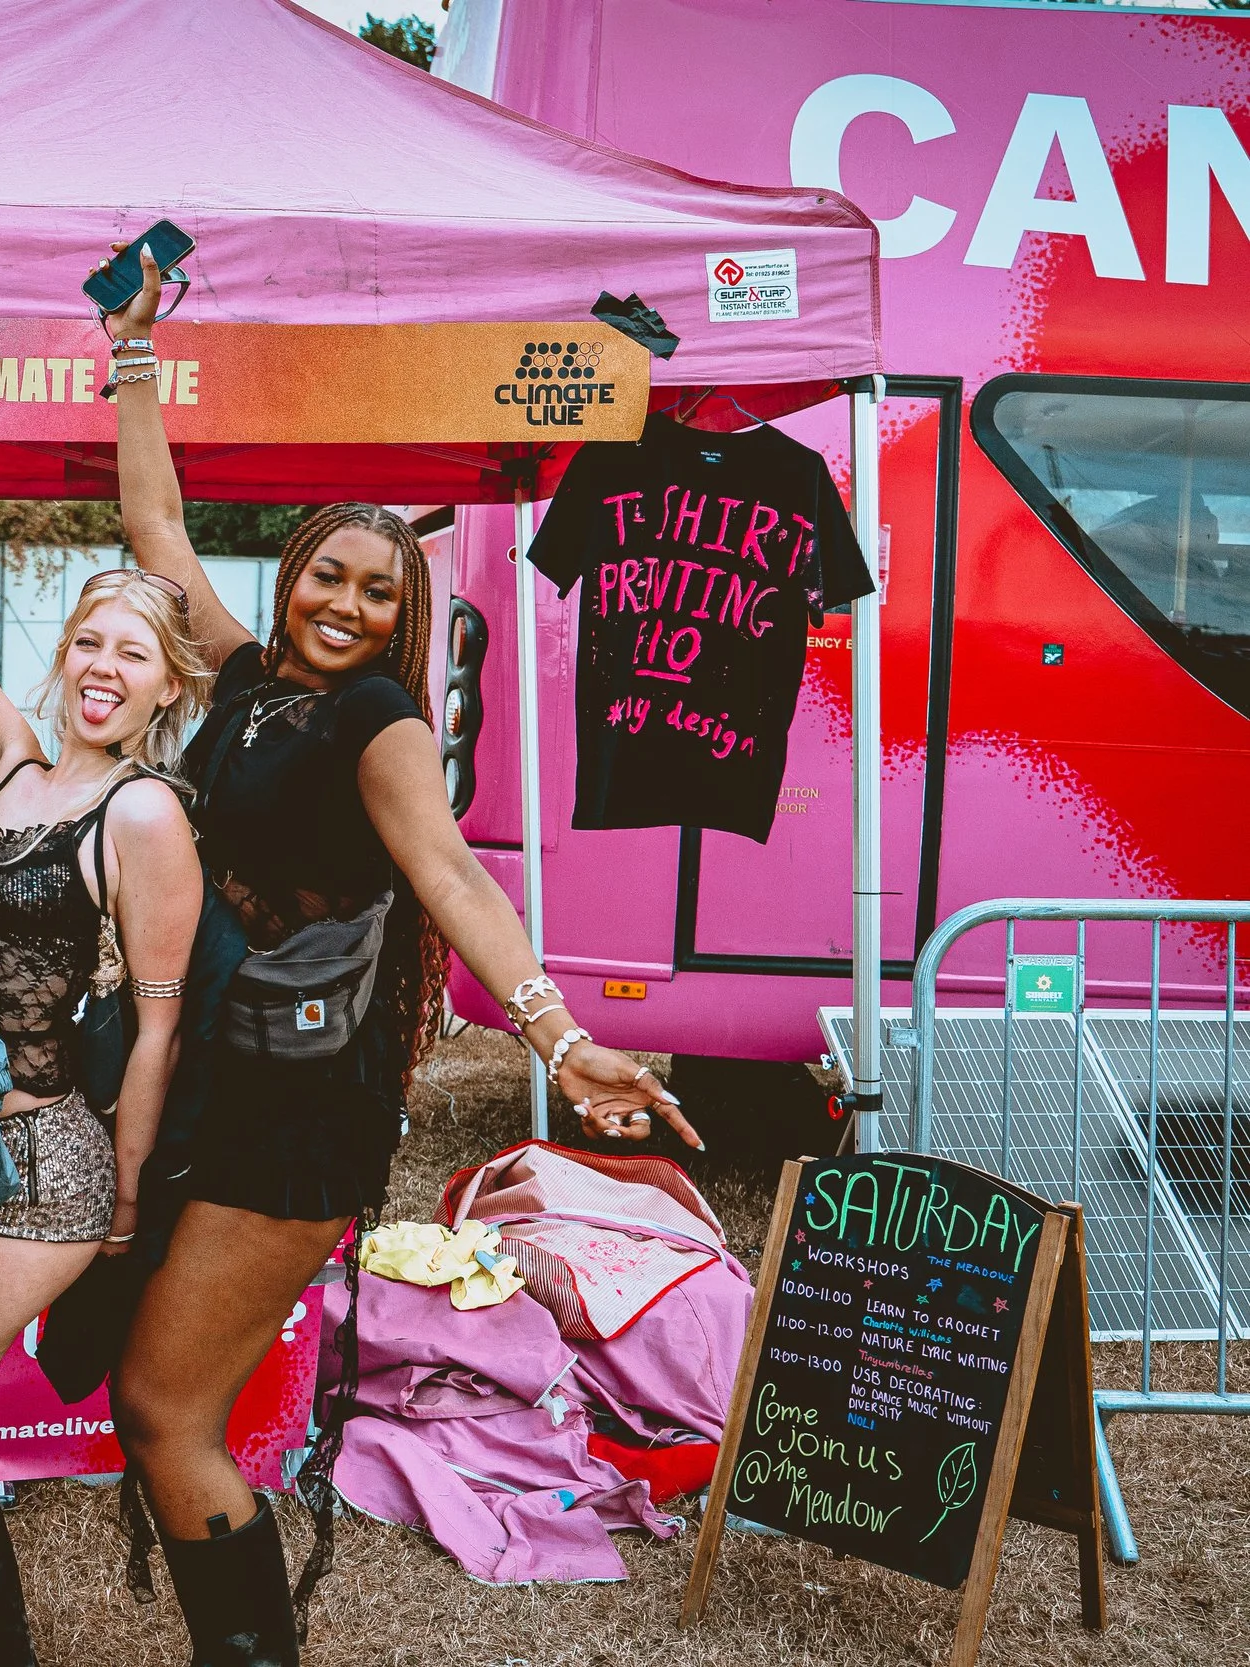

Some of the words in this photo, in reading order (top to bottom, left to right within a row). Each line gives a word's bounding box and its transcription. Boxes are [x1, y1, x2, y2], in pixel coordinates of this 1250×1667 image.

[789, 73, 1250, 286] CAN
[720, 302, 750, 311] INSTANT
[753, 301, 786, 310] SHELTERS
[494, 383, 615, 405] CLIMATE
[667, 700, 753, 758] design
[806, 1160, 1039, 1272] SATURDAY
[808, 1245, 909, 1280] WORKSHOPS
[927, 1256, 951, 1268] THE
[956, 1262, 1015, 1284] MEADOWS
[863, 1315, 904, 1334] Charlotte
[867, 1298, 905, 1318] LEARN
[913, 1311, 929, 1323] TO
[938, 1317, 1000, 1341] CROCHET
[861, 1331, 914, 1353] NATURE
[922, 1344, 952, 1361] LYRIC
[958, 1353, 1008, 1373] WRITING
[853, 1365, 881, 1386] USB
[755, 1381, 818, 1436] Come
[849, 1397, 902, 1421] DIVERSITY
[851, 1384, 865, 1397] NO
[872, 1388, 902, 1407] DANCE
[907, 1398, 938, 1419] MUSIC
[947, 1411, 992, 1435] WITHOUT
[778, 1423, 849, 1466] join
[858, 1449, 903, 1481] us
